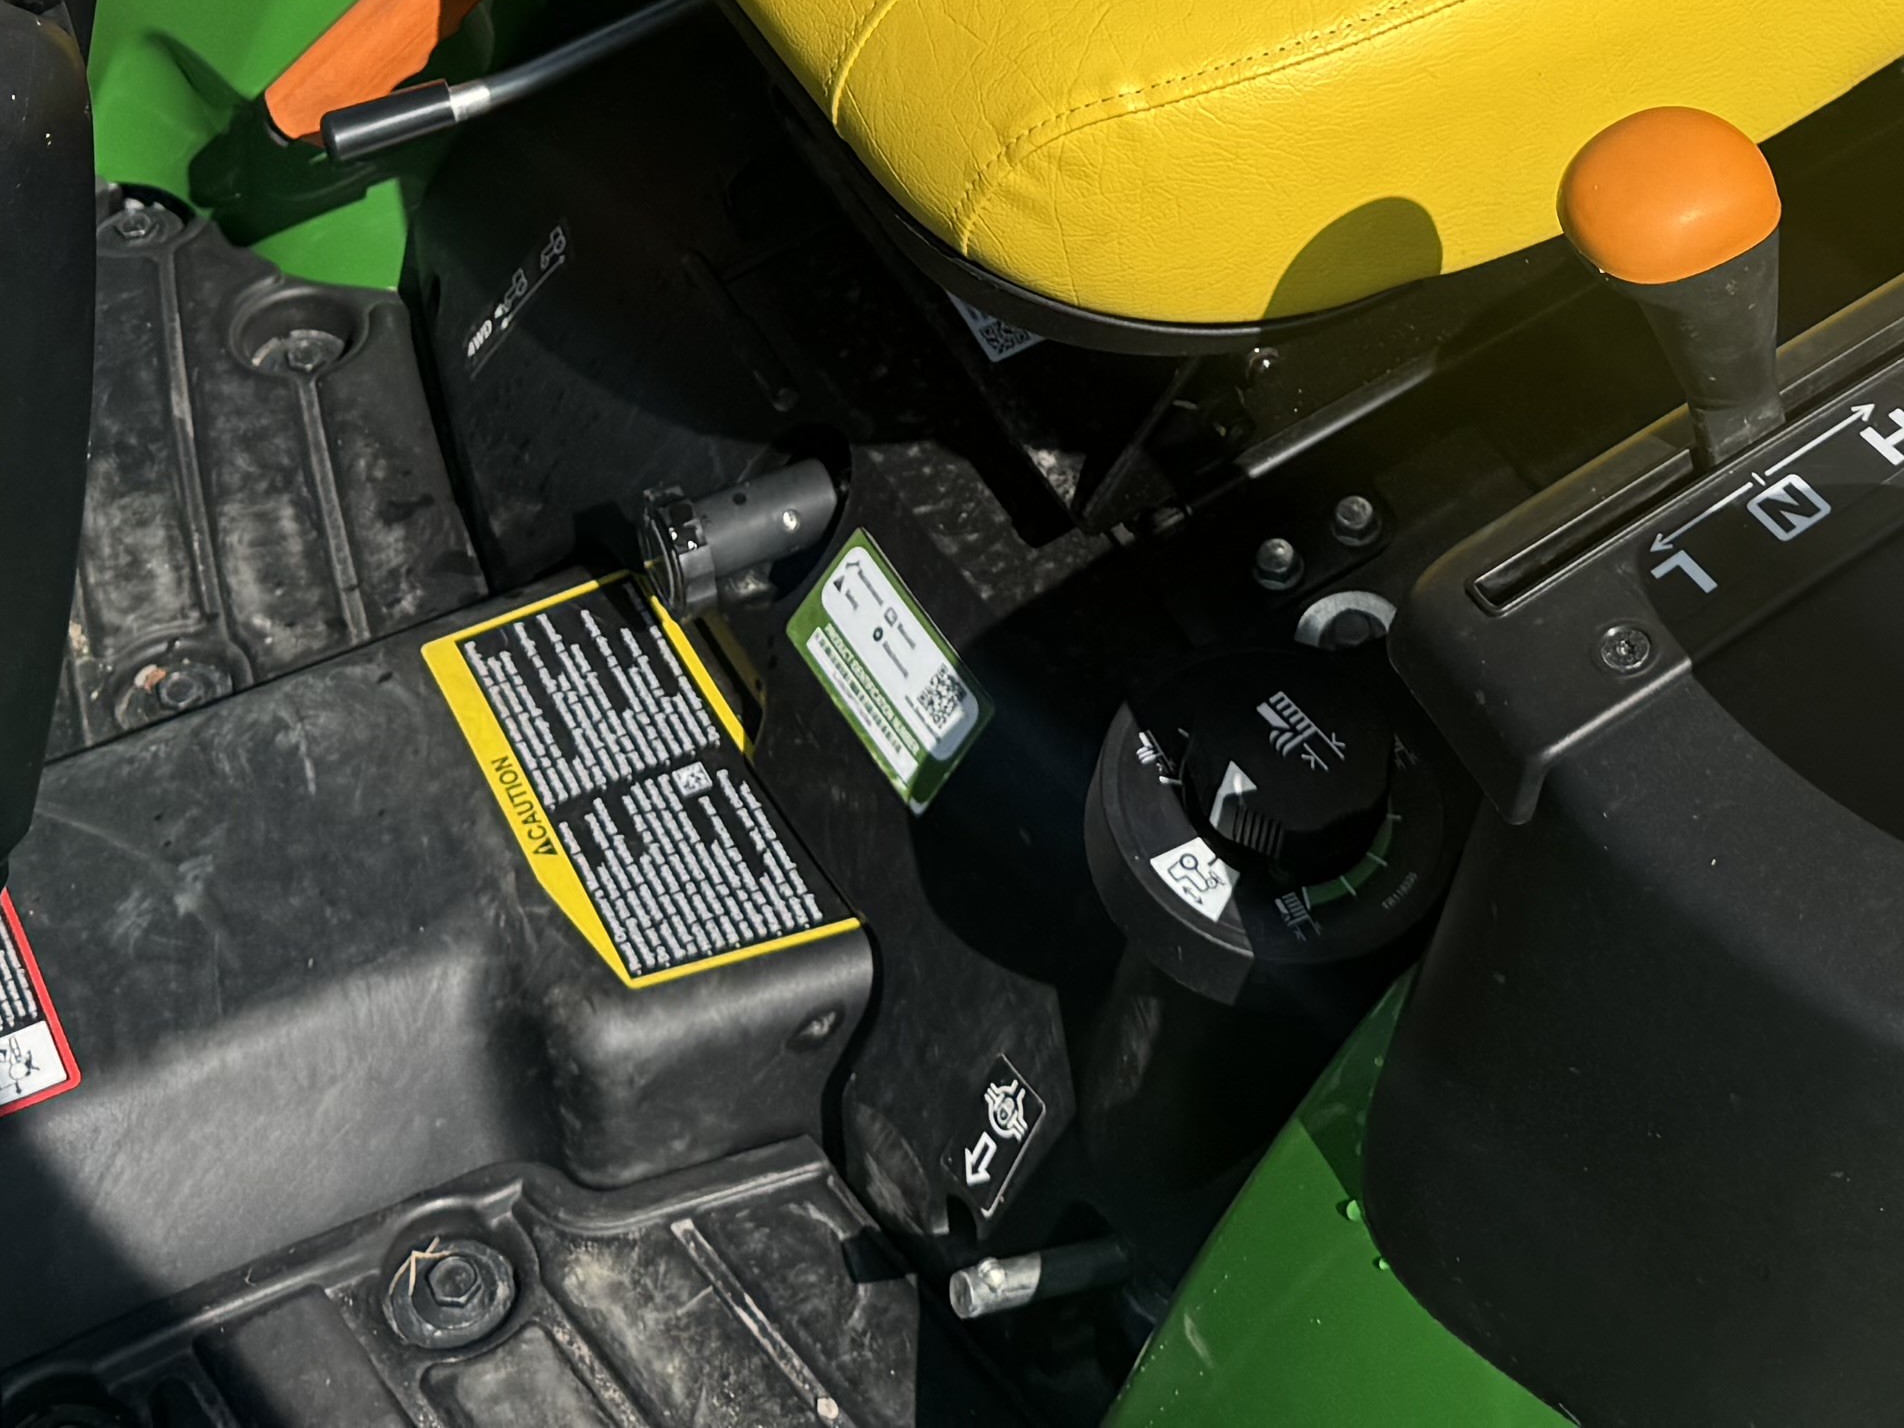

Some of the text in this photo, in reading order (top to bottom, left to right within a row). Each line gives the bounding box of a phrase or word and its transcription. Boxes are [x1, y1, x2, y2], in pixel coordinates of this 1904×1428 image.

[1754, 478, 1824, 538] N
[1651, 550, 1718, 594] L
[491, 755, 550, 843] CAUTION
